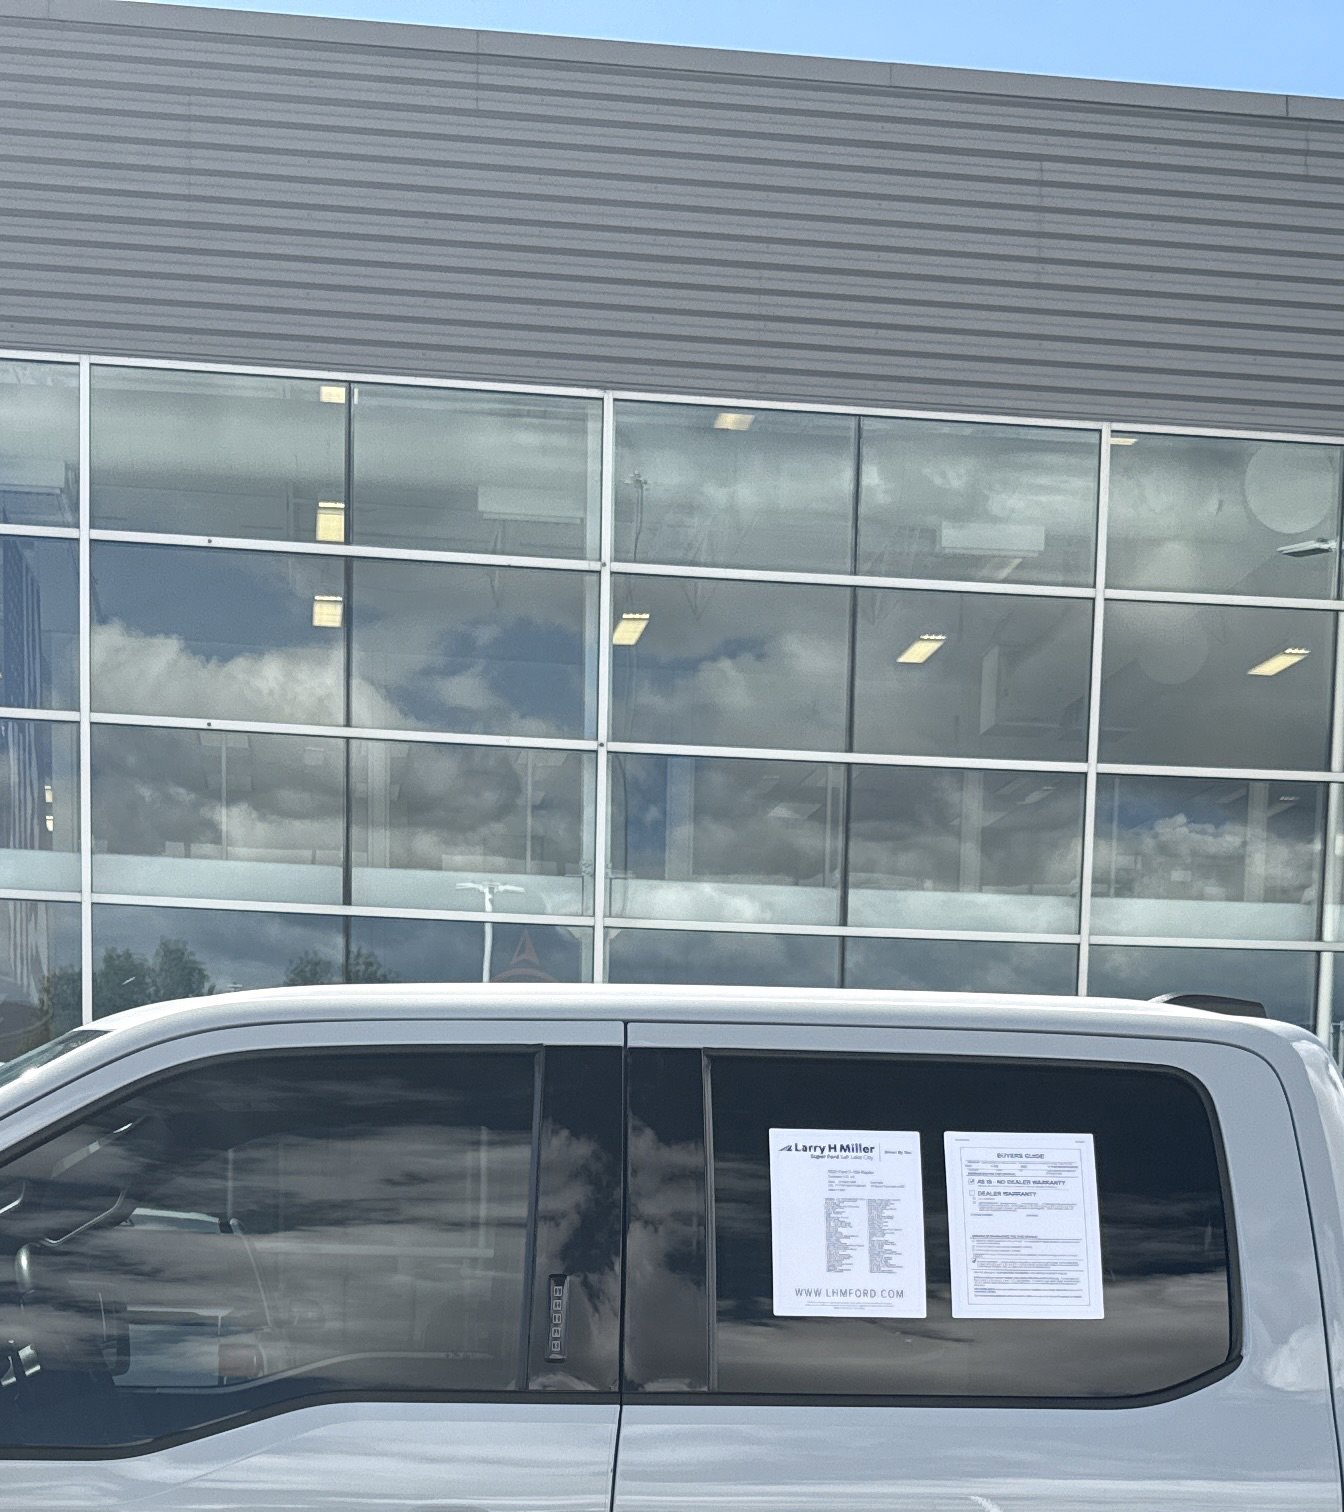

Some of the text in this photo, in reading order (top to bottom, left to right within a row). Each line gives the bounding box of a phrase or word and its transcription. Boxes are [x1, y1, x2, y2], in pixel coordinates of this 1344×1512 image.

[794, 1143, 825, 1155] Larry
[827, 1144, 837, 1153] H
[839, 1143, 875, 1154] Miller
